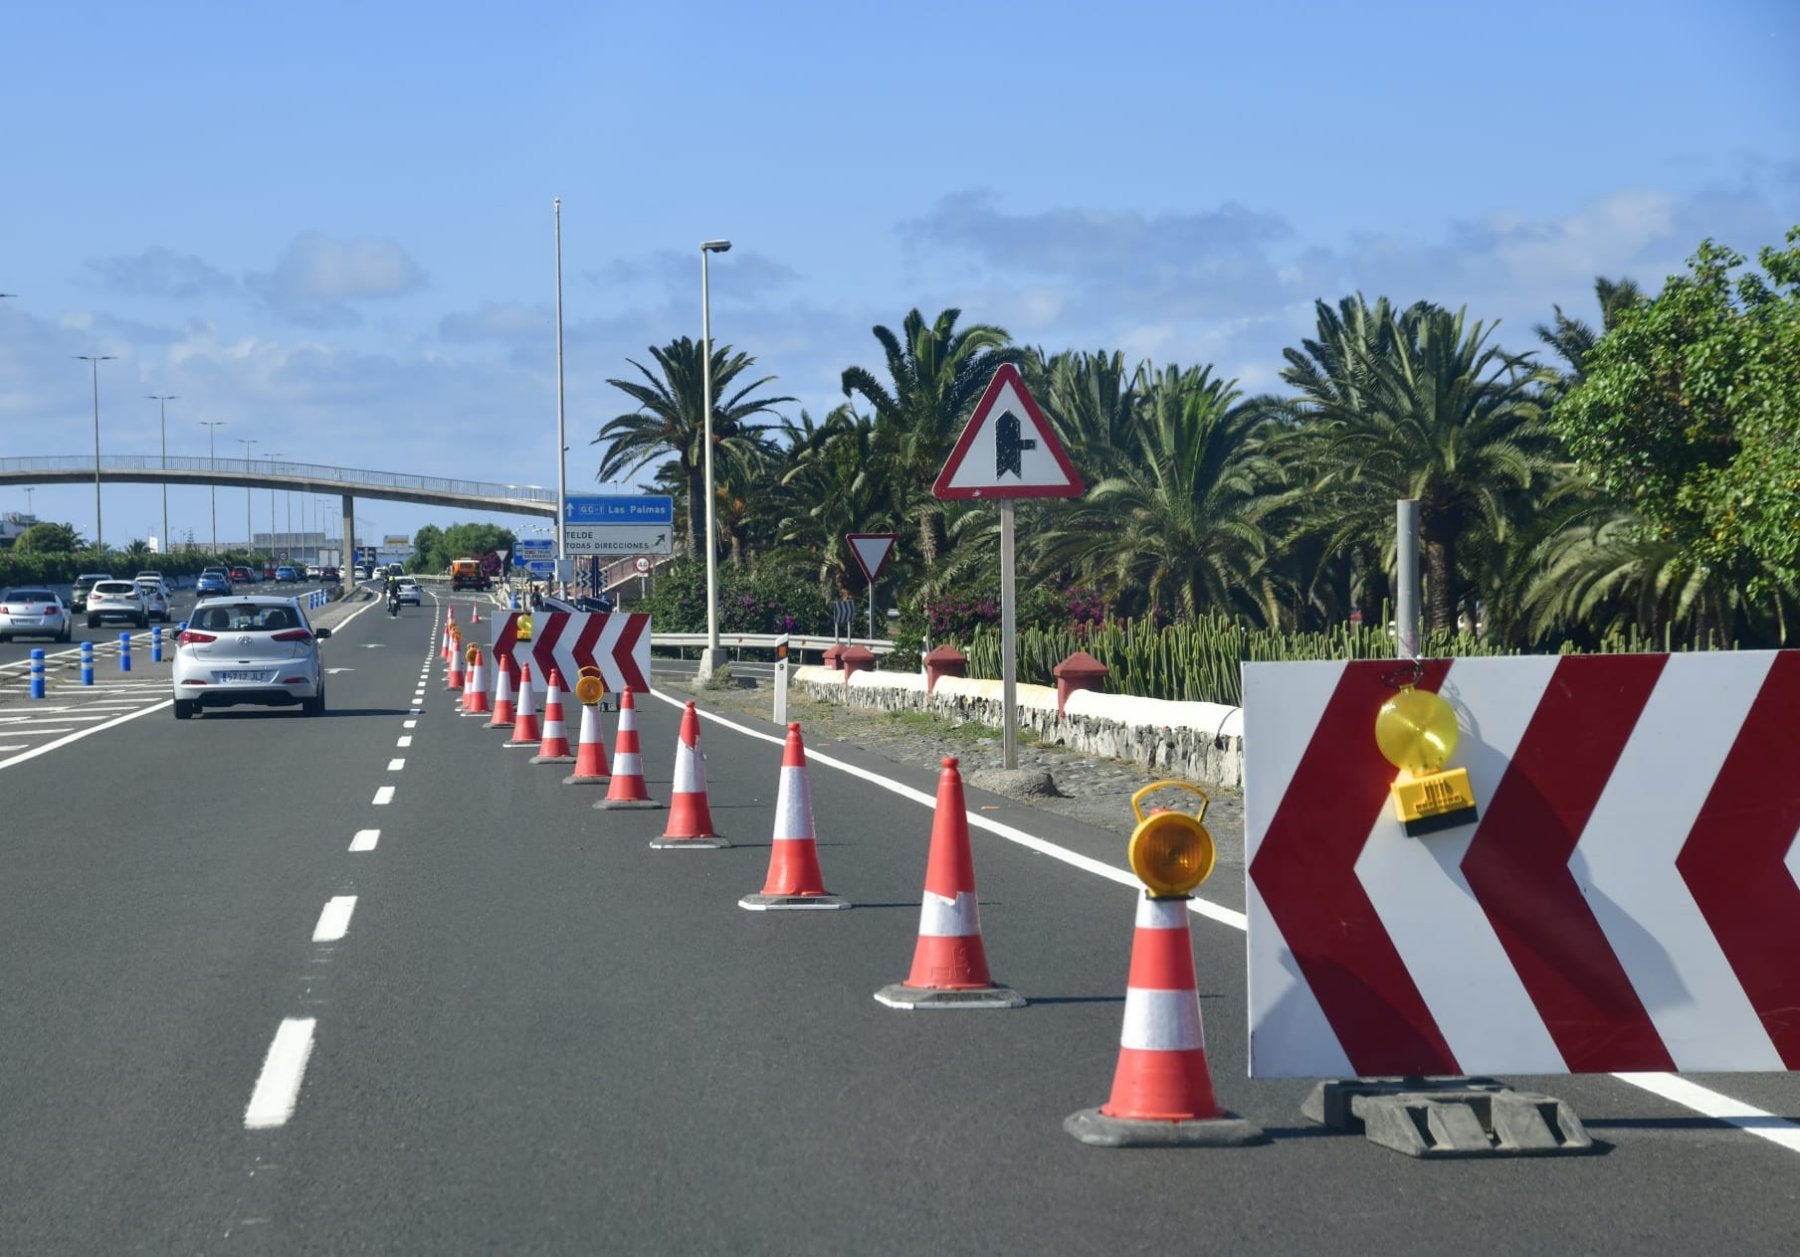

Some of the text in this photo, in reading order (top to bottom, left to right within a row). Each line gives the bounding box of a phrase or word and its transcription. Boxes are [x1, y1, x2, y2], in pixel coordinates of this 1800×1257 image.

[580, 505, 666, 514] GC-1 Las Palmas
[566, 531, 593, 539] TELDE
